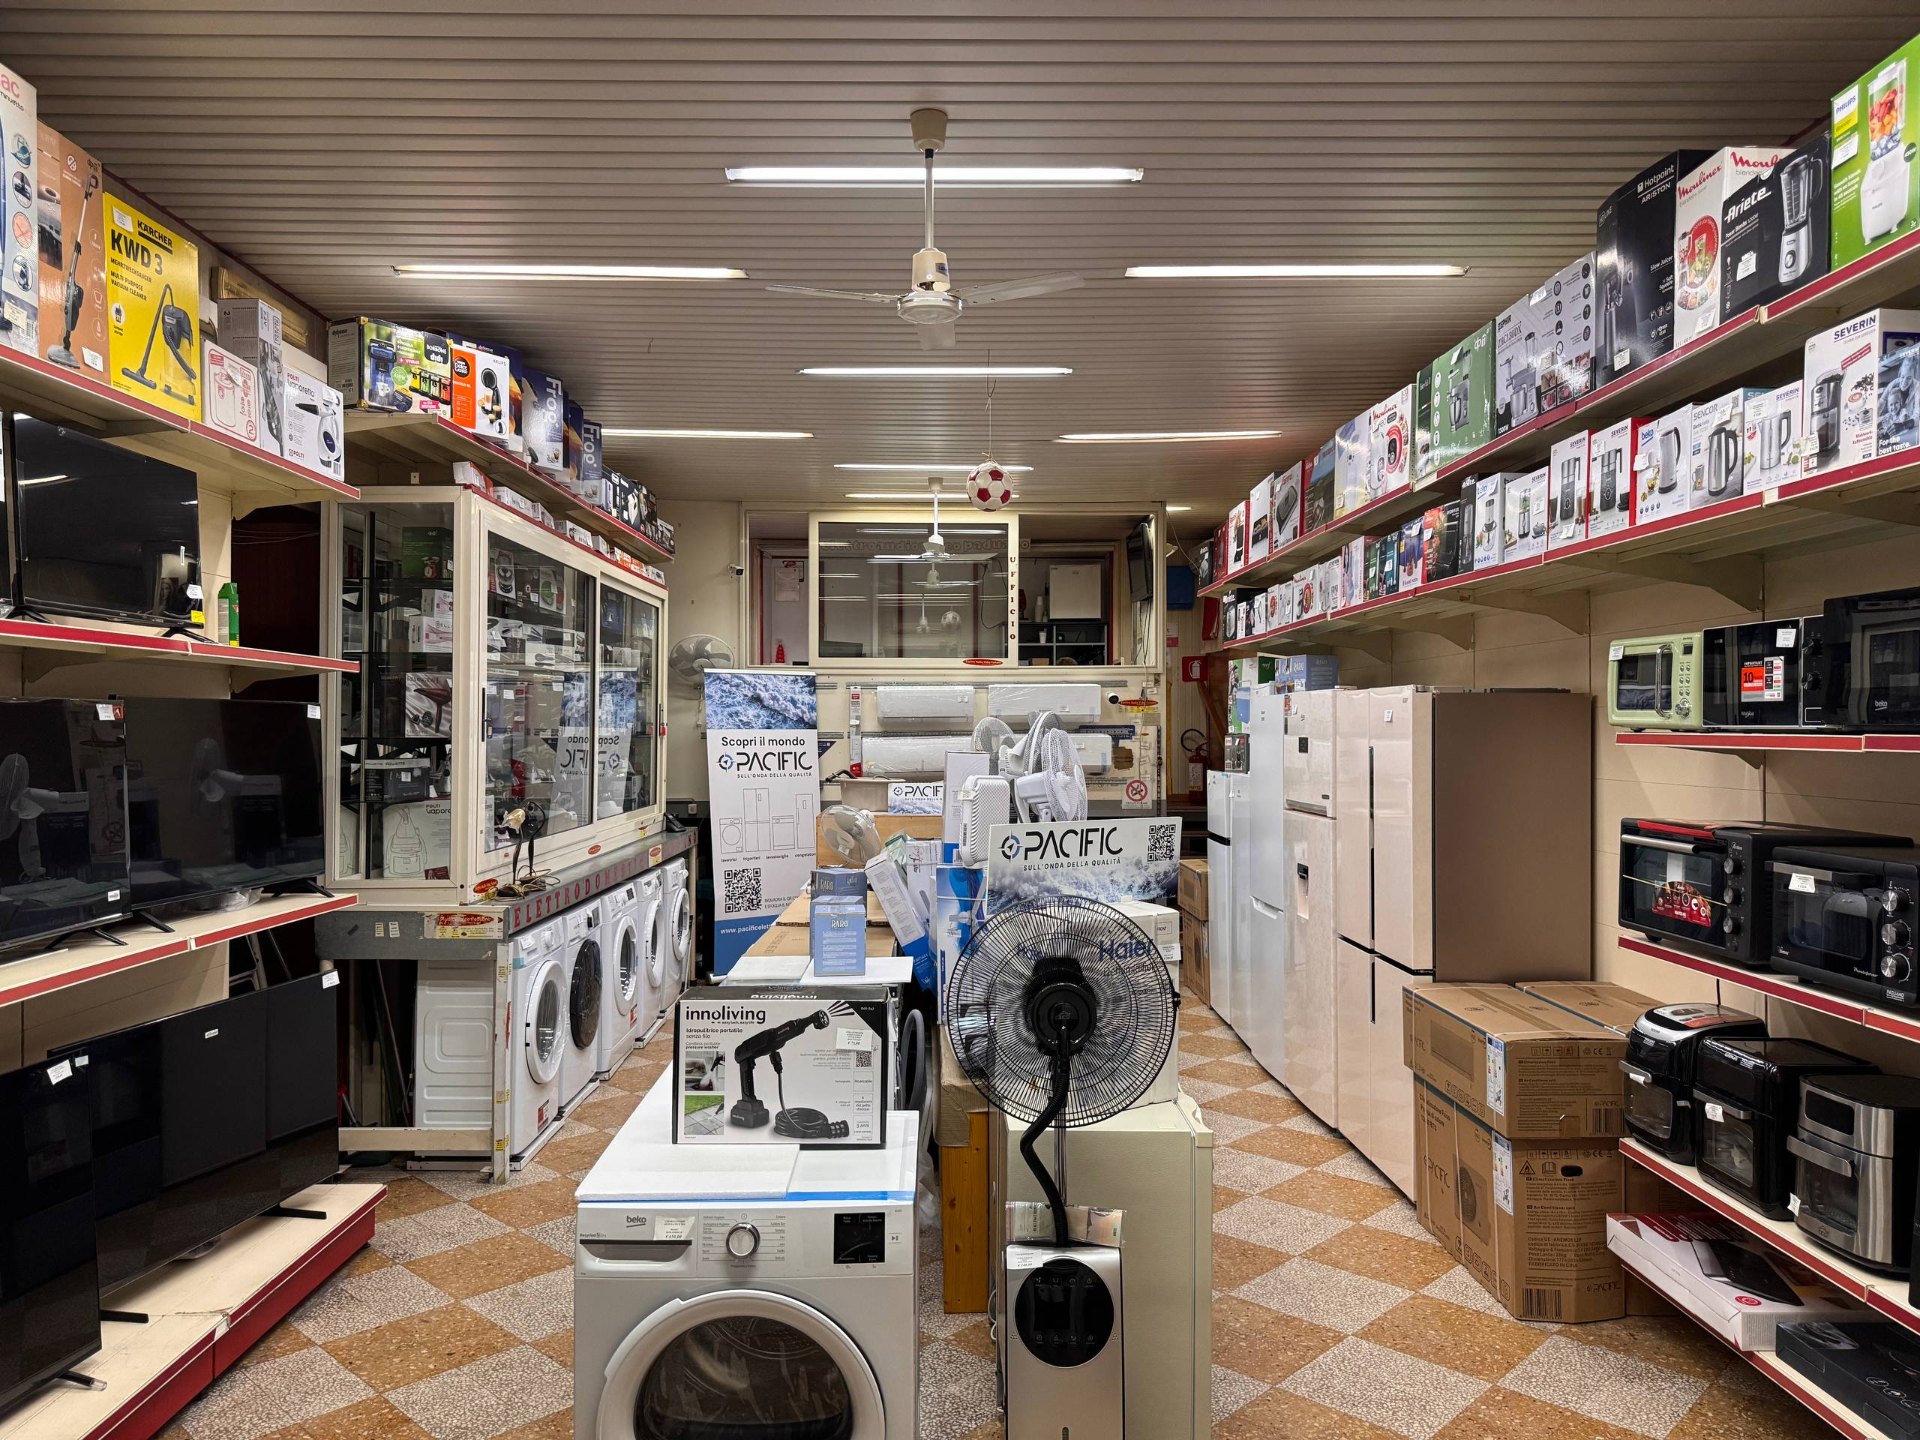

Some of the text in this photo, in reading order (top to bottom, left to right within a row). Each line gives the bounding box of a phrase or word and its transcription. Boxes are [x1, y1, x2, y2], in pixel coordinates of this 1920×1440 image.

[1835, 95, 1857, 114] PHILIPS
[1644, 164, 1675, 188] Hotpoint
[1678, 164, 1722, 200] Moulinex
[1641, 182, 1671, 204] ARISTON
[1724, 186, 1772, 223] Ariete
[137, 219, 173, 248] KÄRCHER
[111, 228, 162, 275] KWD 3
[129, 286, 147, 301] CLEANER
[1834, 315, 1877, 341] SEVERIN
[287, 372, 300, 383] POLTI
[1775, 388, 1800, 401] SEVERIN
[1693, 404, 1718, 421] SENCOR
[1611, 425, 1629, 438] SEVERIN
[1641, 429, 1654, 441] beko
[1570, 437, 1586, 449] SEVERIN
[293, 450, 305, 459] POLTI
[1532, 473, 1547, 484] SEVERIN
[1874, 700, 1888, 708] beko
[721, 736, 806, 749] Scopri il mondo
[736, 751, 813, 772] PACIFIC
[904, 785, 944, 798] PACIF
[1023, 826, 1124, 861] PACIFIC
[1023, 856, 1122, 872] SULL'ONDA DELLA QUALITÀ
[820, 879, 834, 891] RARO
[831, 920, 849, 929] RARO
[686, 1005, 766, 1024] innoliving
[626, 1215, 647, 1224] beko
